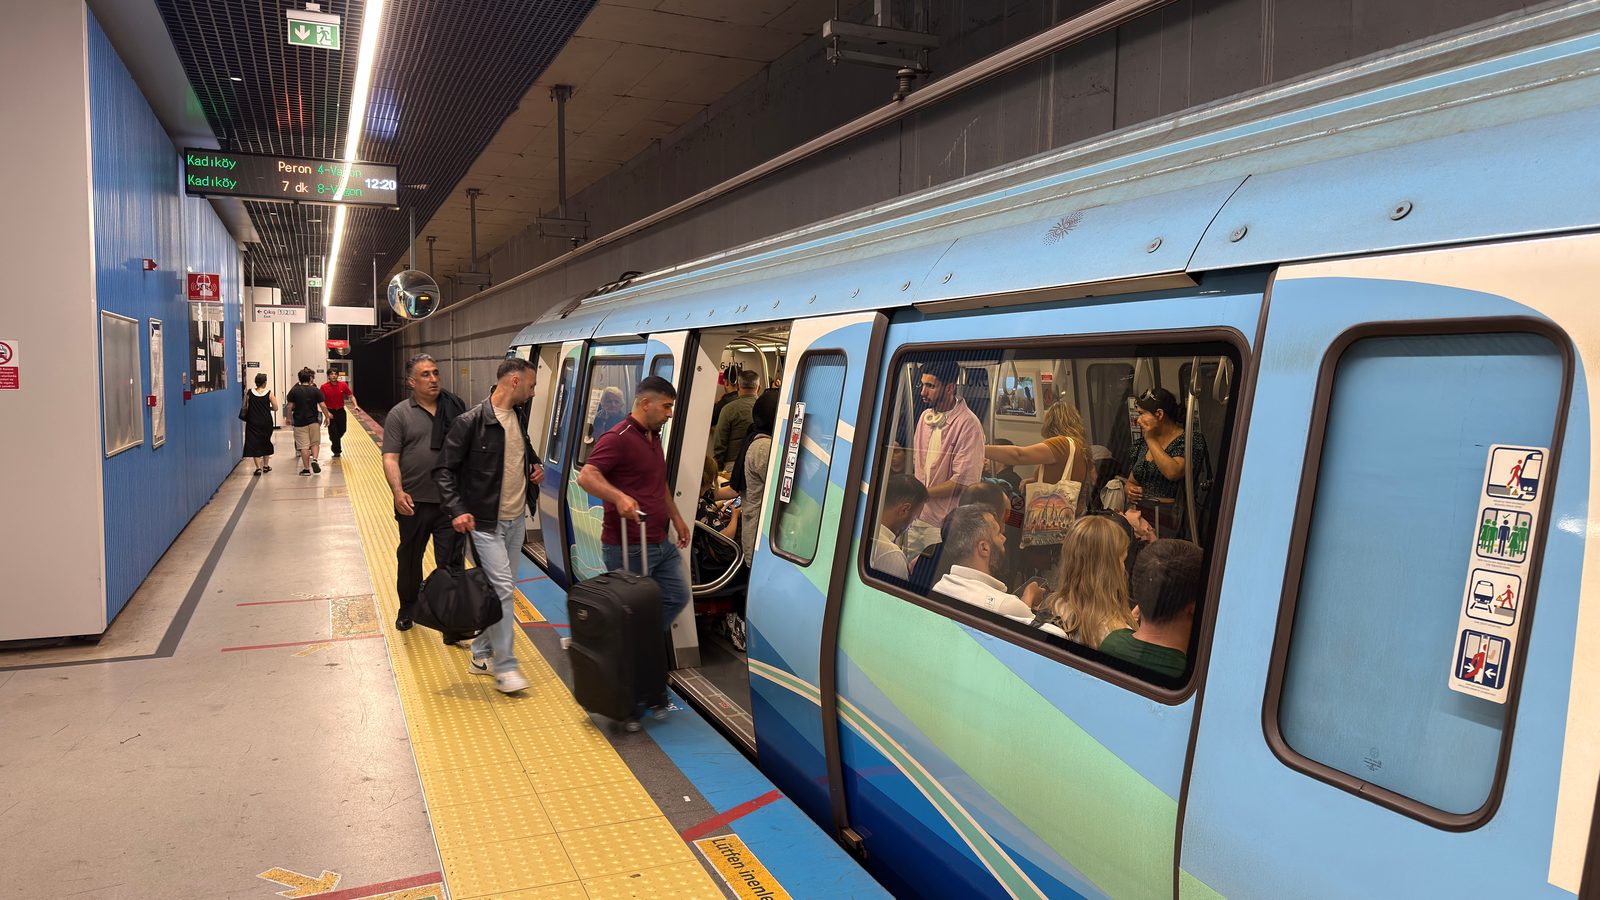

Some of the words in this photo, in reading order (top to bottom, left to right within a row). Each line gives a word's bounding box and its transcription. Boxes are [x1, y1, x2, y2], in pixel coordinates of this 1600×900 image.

[187, 154, 237, 169] Kadıköy
[278, 161, 312, 175] Peron
[317, 164, 363, 177] 4-Vaon
[187, 174, 237, 189] Kadıköy
[282, 181, 289, 192] 7
[295, 182, 308, 193] dk
[317, 183, 363, 197] 8-Vgon
[365, 178, 397, 190] 12:20
[712, 838, 745, 869] Lütfen
